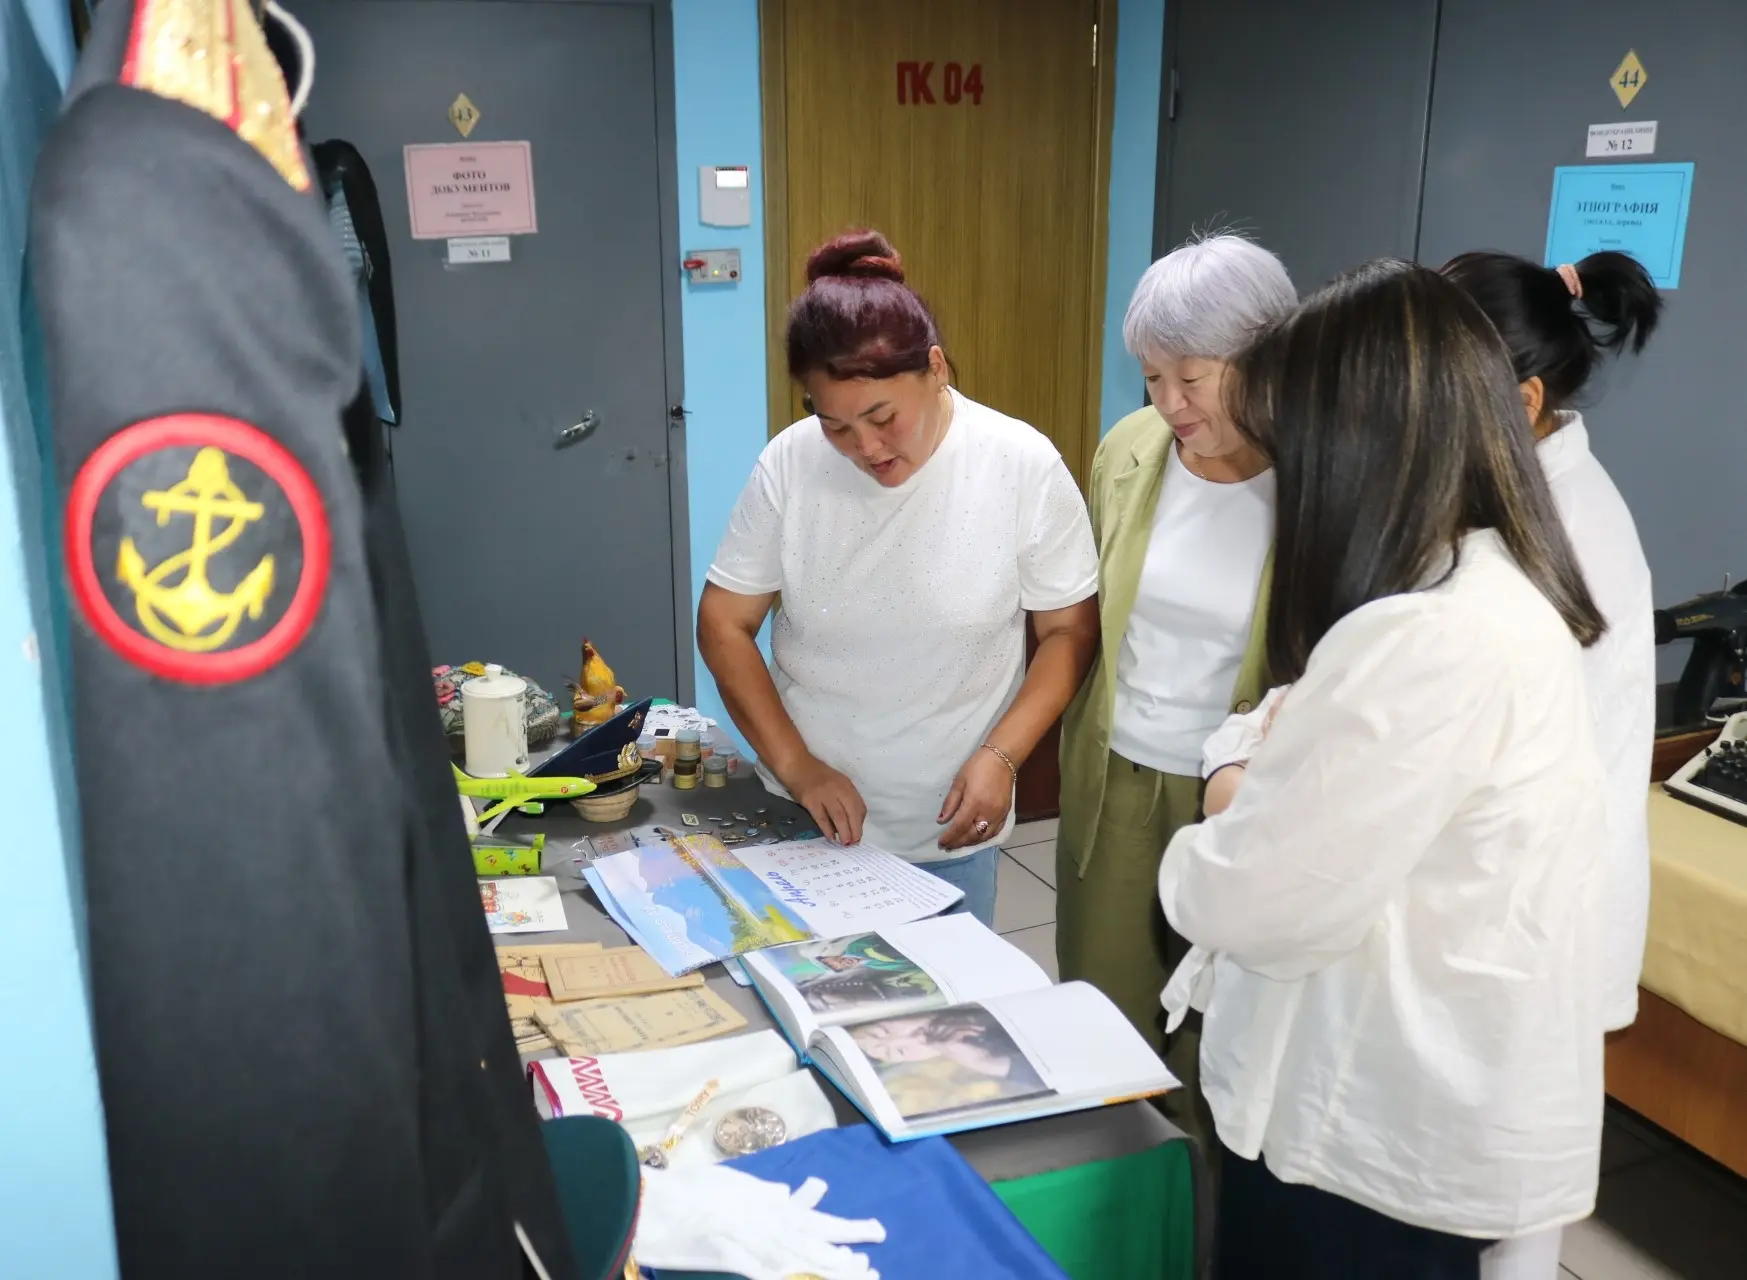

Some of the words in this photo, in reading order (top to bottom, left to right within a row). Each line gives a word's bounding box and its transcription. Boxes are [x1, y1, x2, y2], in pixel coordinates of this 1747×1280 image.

[896, 62, 936, 105] ПК
[943, 63, 985, 105] 04
[1618, 68, 1640, 89] 44
[1621, 138, 1633, 150] 12
[452, 170, 486, 181] ФОТО
[431, 182, 511, 196] ДОКУМЕНТОВ
[1576, 201, 1659, 214] ЭТНОГРАФИЯ
